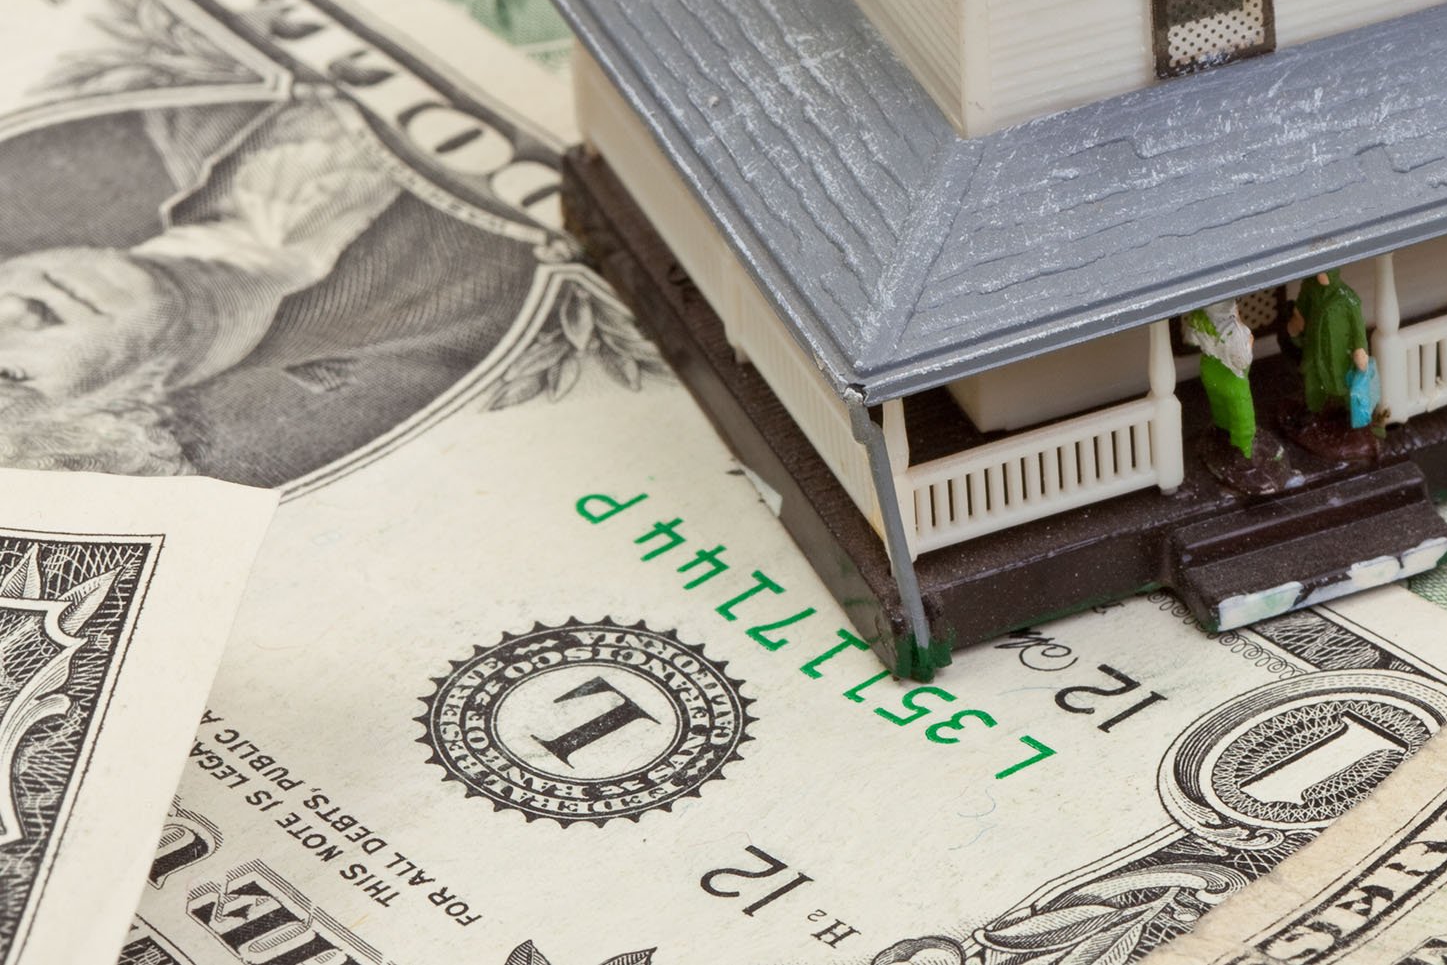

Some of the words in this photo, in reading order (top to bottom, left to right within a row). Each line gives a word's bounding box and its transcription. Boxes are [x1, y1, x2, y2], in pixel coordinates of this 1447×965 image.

[575, 492, 1058, 781] L35117144P
[529, 676, 662, 770] L
[1053, 662, 1169, 734] 12
[187, 741, 252, 790] LEGA
[213, 728, 306, 793] PUBLIC
[1238, 709, 1411, 806] 1
[244, 789, 284, 813] IS
[301, 786, 389, 856] DEBTS,
[275, 811, 344, 863] NOTE
[382, 851, 437, 887] ALL
[338, 863, 402, 908] THIS
[427, 886, 484, 927] FOR
[700, 844, 815, 918] 12
